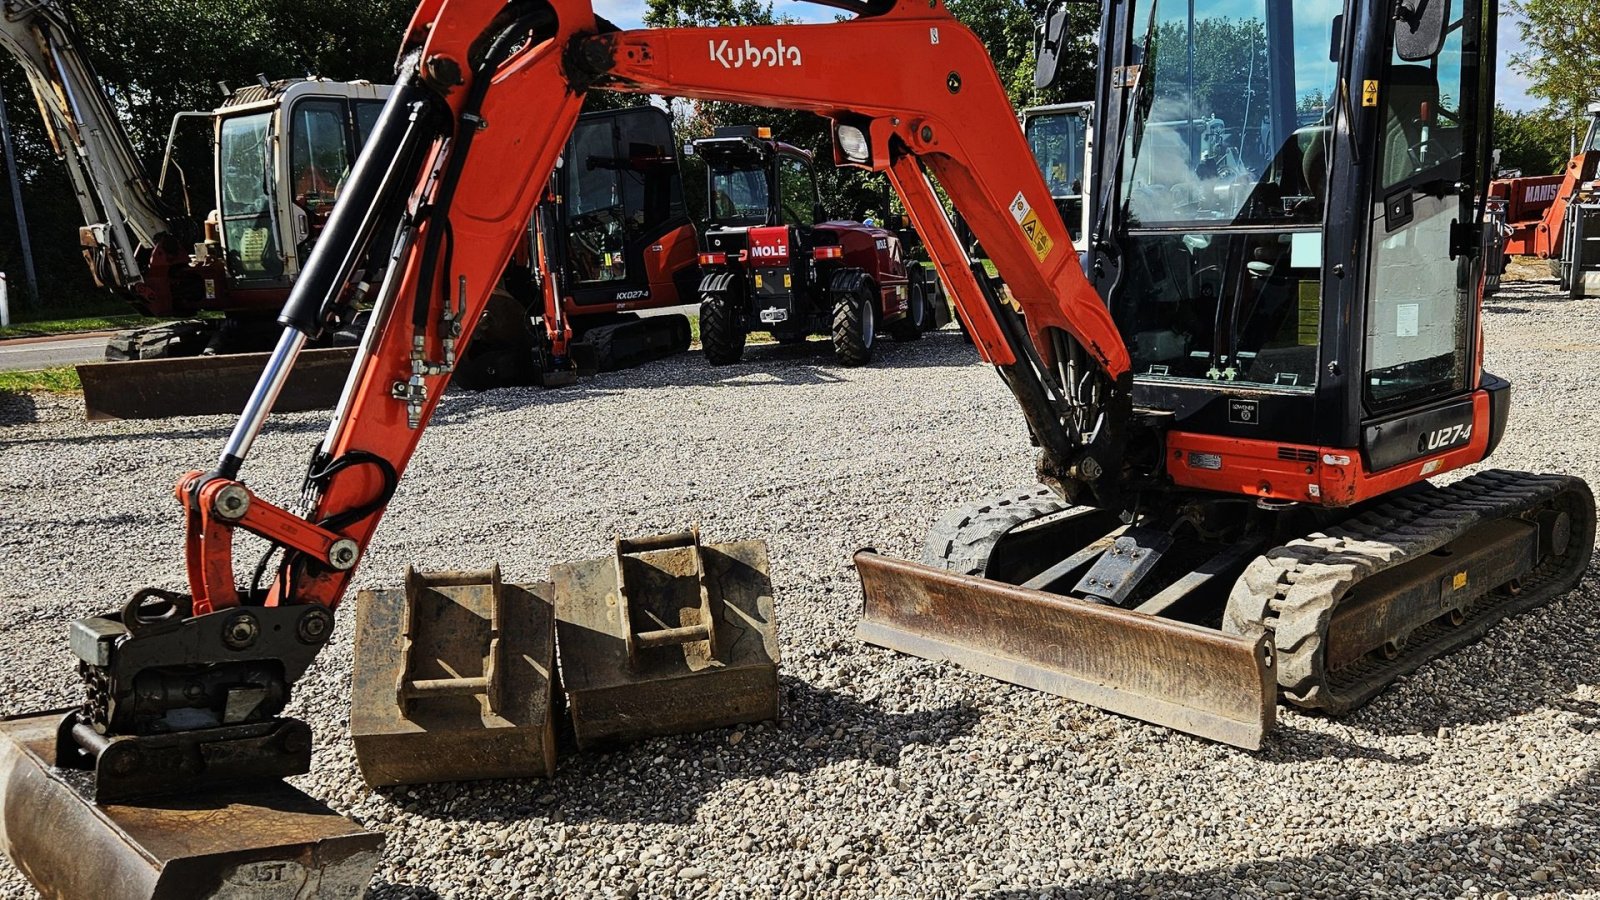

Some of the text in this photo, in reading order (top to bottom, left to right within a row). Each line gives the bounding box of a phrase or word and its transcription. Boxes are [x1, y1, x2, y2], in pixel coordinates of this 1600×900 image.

[709, 39, 802, 69] Kubota
[752, 245, 787, 257] MOLE
[1427, 423, 1473, 450] U27-4
